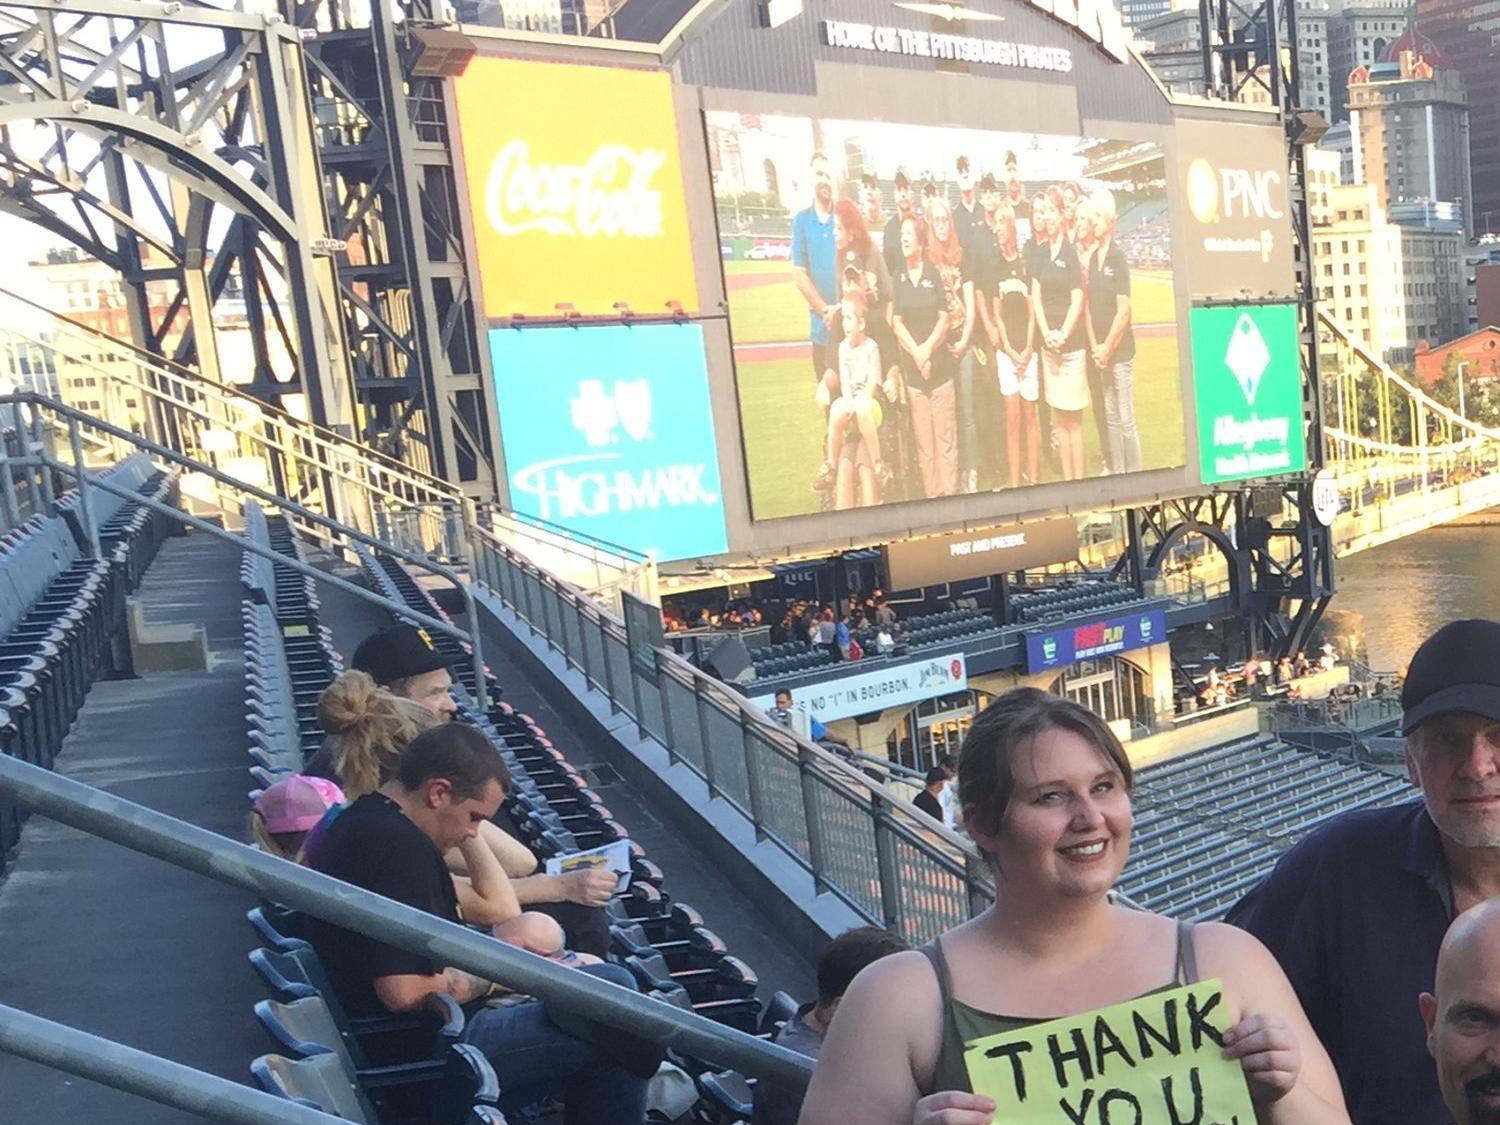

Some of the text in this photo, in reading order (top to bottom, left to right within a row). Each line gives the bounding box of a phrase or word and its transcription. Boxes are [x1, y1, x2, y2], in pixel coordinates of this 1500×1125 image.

[827, 20, 1072, 72] HOME OF THE PITTSBURGH PIRATES
[1218, 167, 1284, 219] PNC
[1103, 625, 1125, 643] PLAY
[811, 696, 826, 712] NO
[847, 689, 858, 703] IN
[861, 678, 912, 701] BOURBON.
[984, 991, 1228, 1103] THANK
